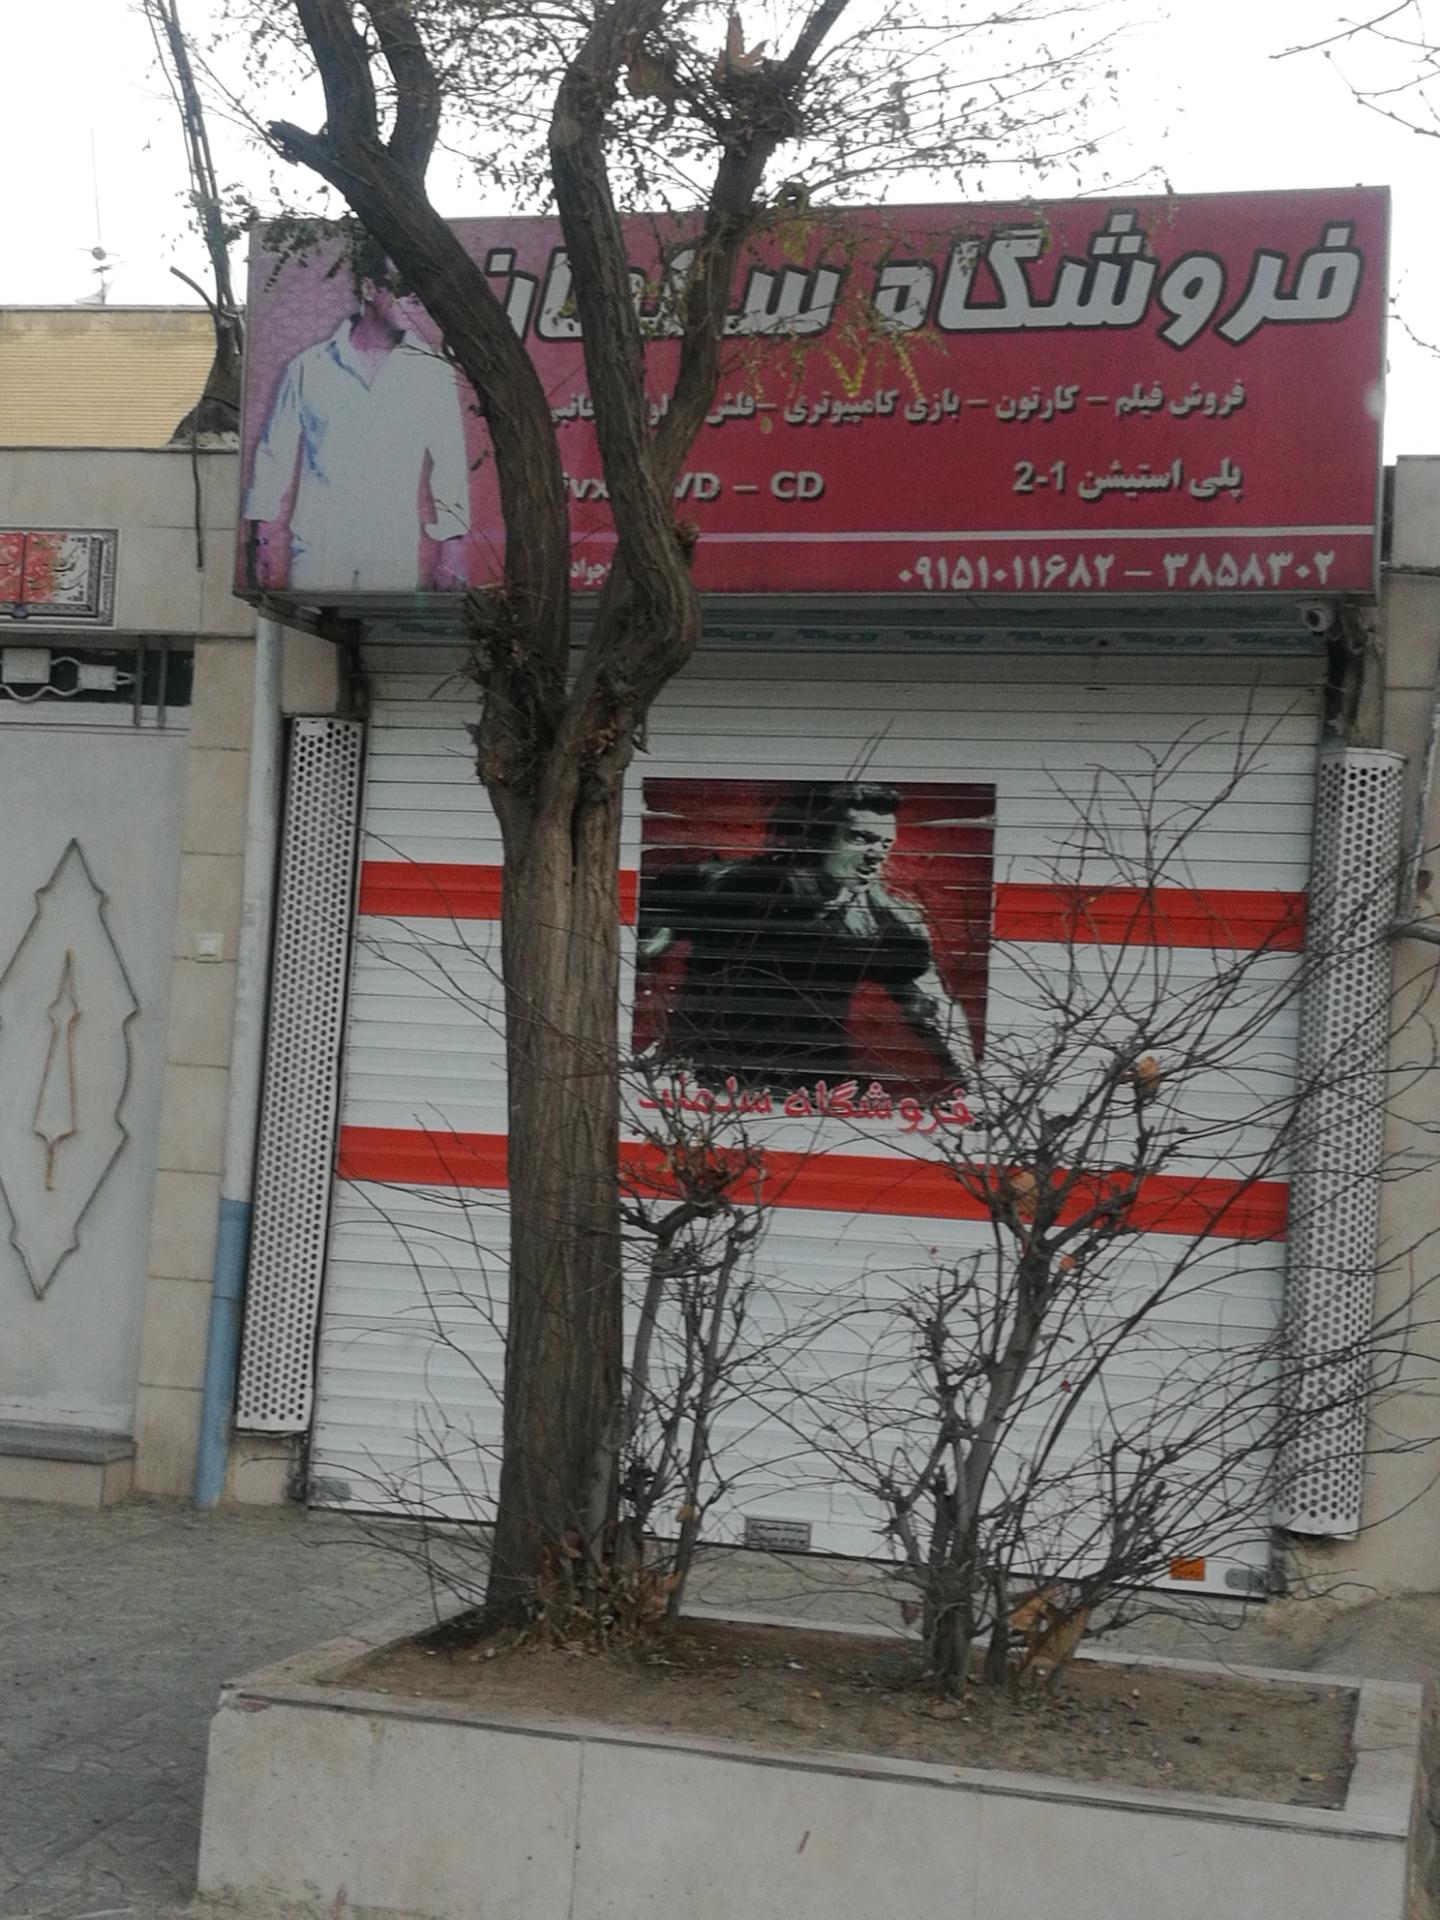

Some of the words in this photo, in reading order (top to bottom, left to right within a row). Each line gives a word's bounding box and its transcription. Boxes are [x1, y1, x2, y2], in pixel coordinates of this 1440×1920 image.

[873, 210, 1363, 348] فروشگاه
[783, 388, 899, 424] کامپیوتری
[904, 386, 961, 422] بازی
[994, 385, 1079, 420] کارتون
[1114, 380, 1165, 417] فیلم
[1167, 379, 1246, 417] فروش
[769, 471, 825, 499] CD
[1076, 457, 1183, 500] استیشن
[1188, 457, 1243, 498] پلی
[898, 553, 1115, 590] ۰۹۱۵۱۰۱۱۶۸۲
[1162, 550, 1336, 588] ۳۸۵۸۳۰۲
[783, 1079, 975, 1134] فروشگاه
